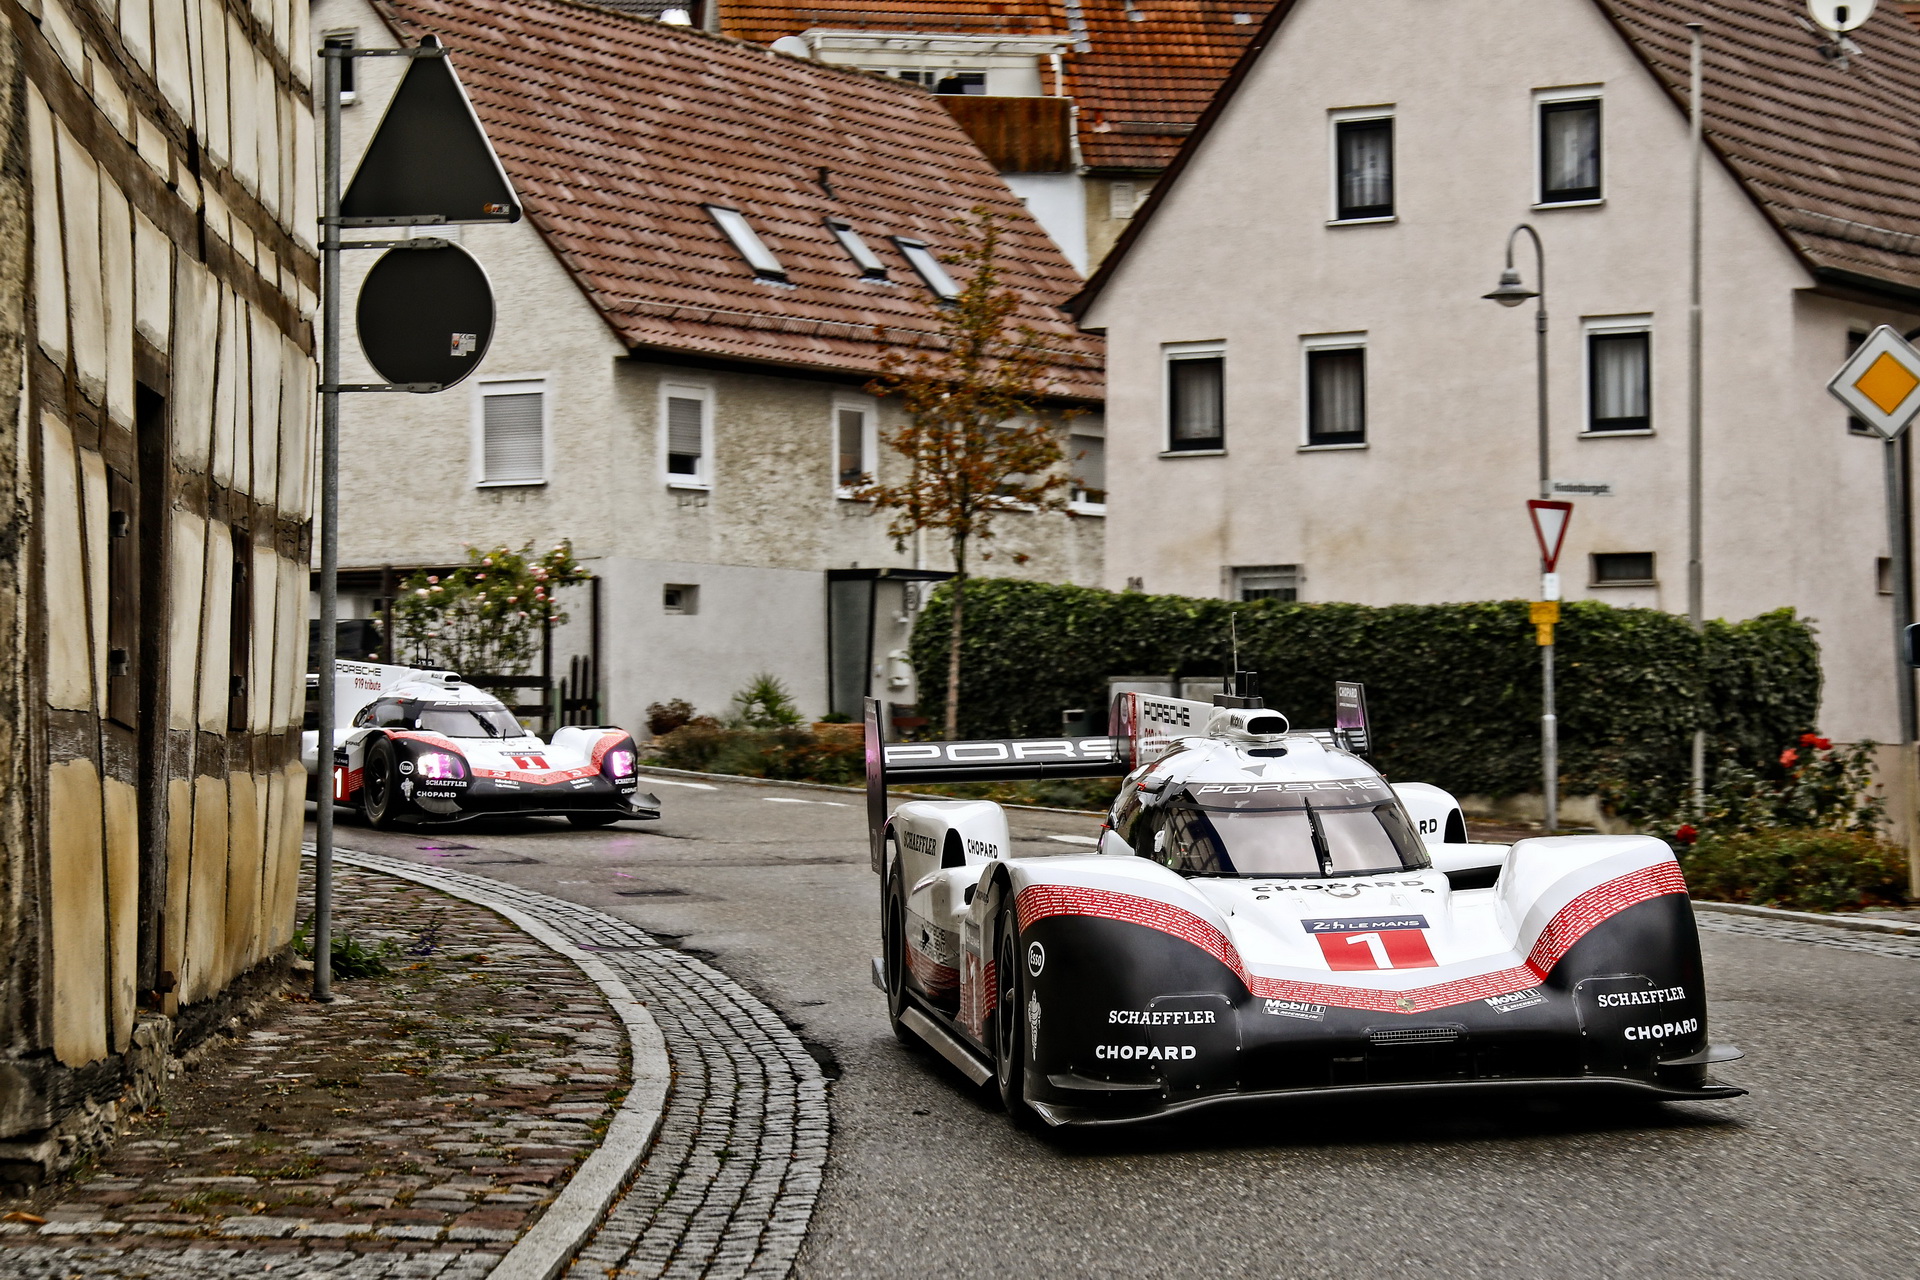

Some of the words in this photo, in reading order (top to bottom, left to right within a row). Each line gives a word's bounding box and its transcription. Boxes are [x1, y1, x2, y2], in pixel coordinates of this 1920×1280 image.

[336, 664, 381, 676] PORSCHE
[1144, 701, 1190, 727] PORSCHE
[520, 756, 542, 769] 1
[334, 767, 343, 799] 1
[425, 779, 467, 787] SCHAEFFLER
[1196, 779, 1381, 796] PORSCHE
[904, 831, 937, 856] SCHAEFFLER
[967, 838, 998, 859] CHOPARD
[1252, 880, 1424, 893] CHOPARD
[1372, 920, 1419, 928] MANS
[1345, 932, 1394, 969] 1
[1484, 991, 1527, 1006] Mobil
[1597, 986, 1686, 1008] SCHAEFFLER
[1265, 998, 1310, 1012] Mobil
[1108, 1010, 1216, 1025] SCHAEFFLER
[1624, 1018, 1698, 1040] CHOPARD
[1095, 1045, 1197, 1060] CHOPARD
